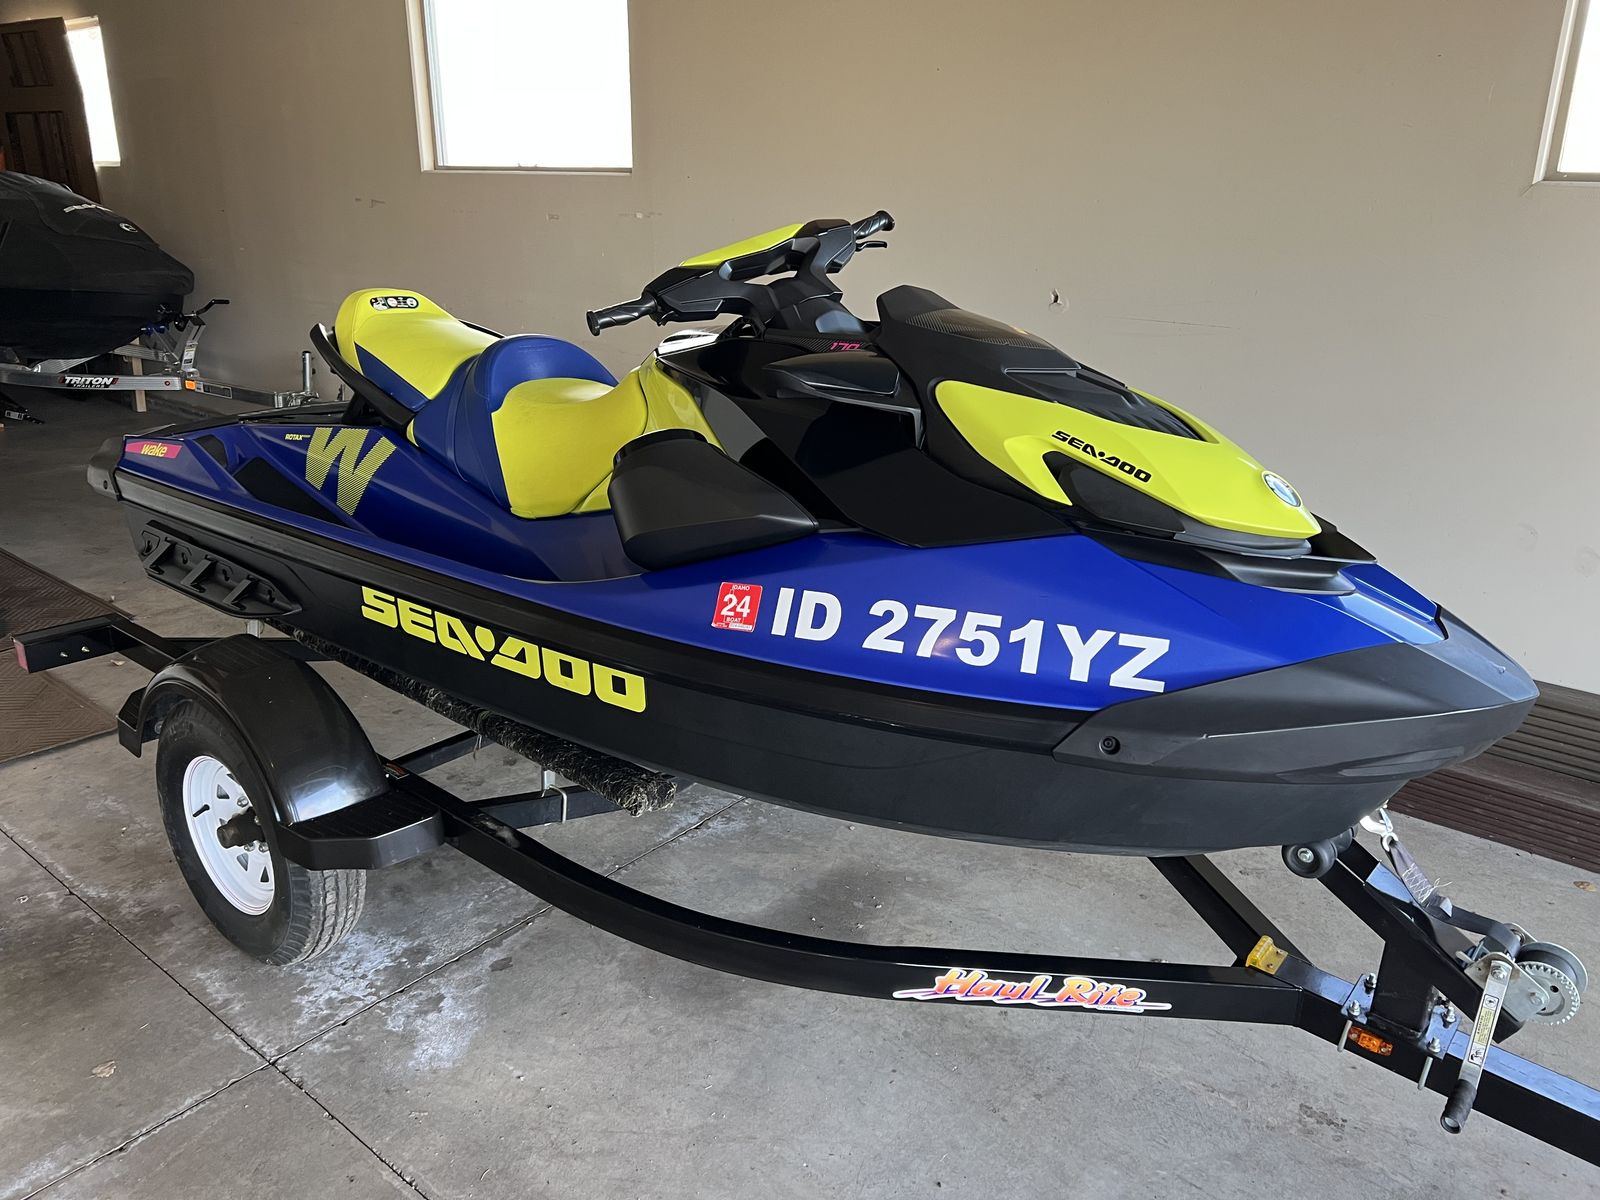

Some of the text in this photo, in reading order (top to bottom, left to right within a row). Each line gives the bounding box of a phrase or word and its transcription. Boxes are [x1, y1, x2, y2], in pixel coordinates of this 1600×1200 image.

[64, 375, 113, 385] TRITON
[141, 443, 168, 457] wake
[720, 593, 751, 618] 24
[771, 587, 1170, 693] ID 2751YZ
[935, 968, 1144, 1007] Haul Rite
